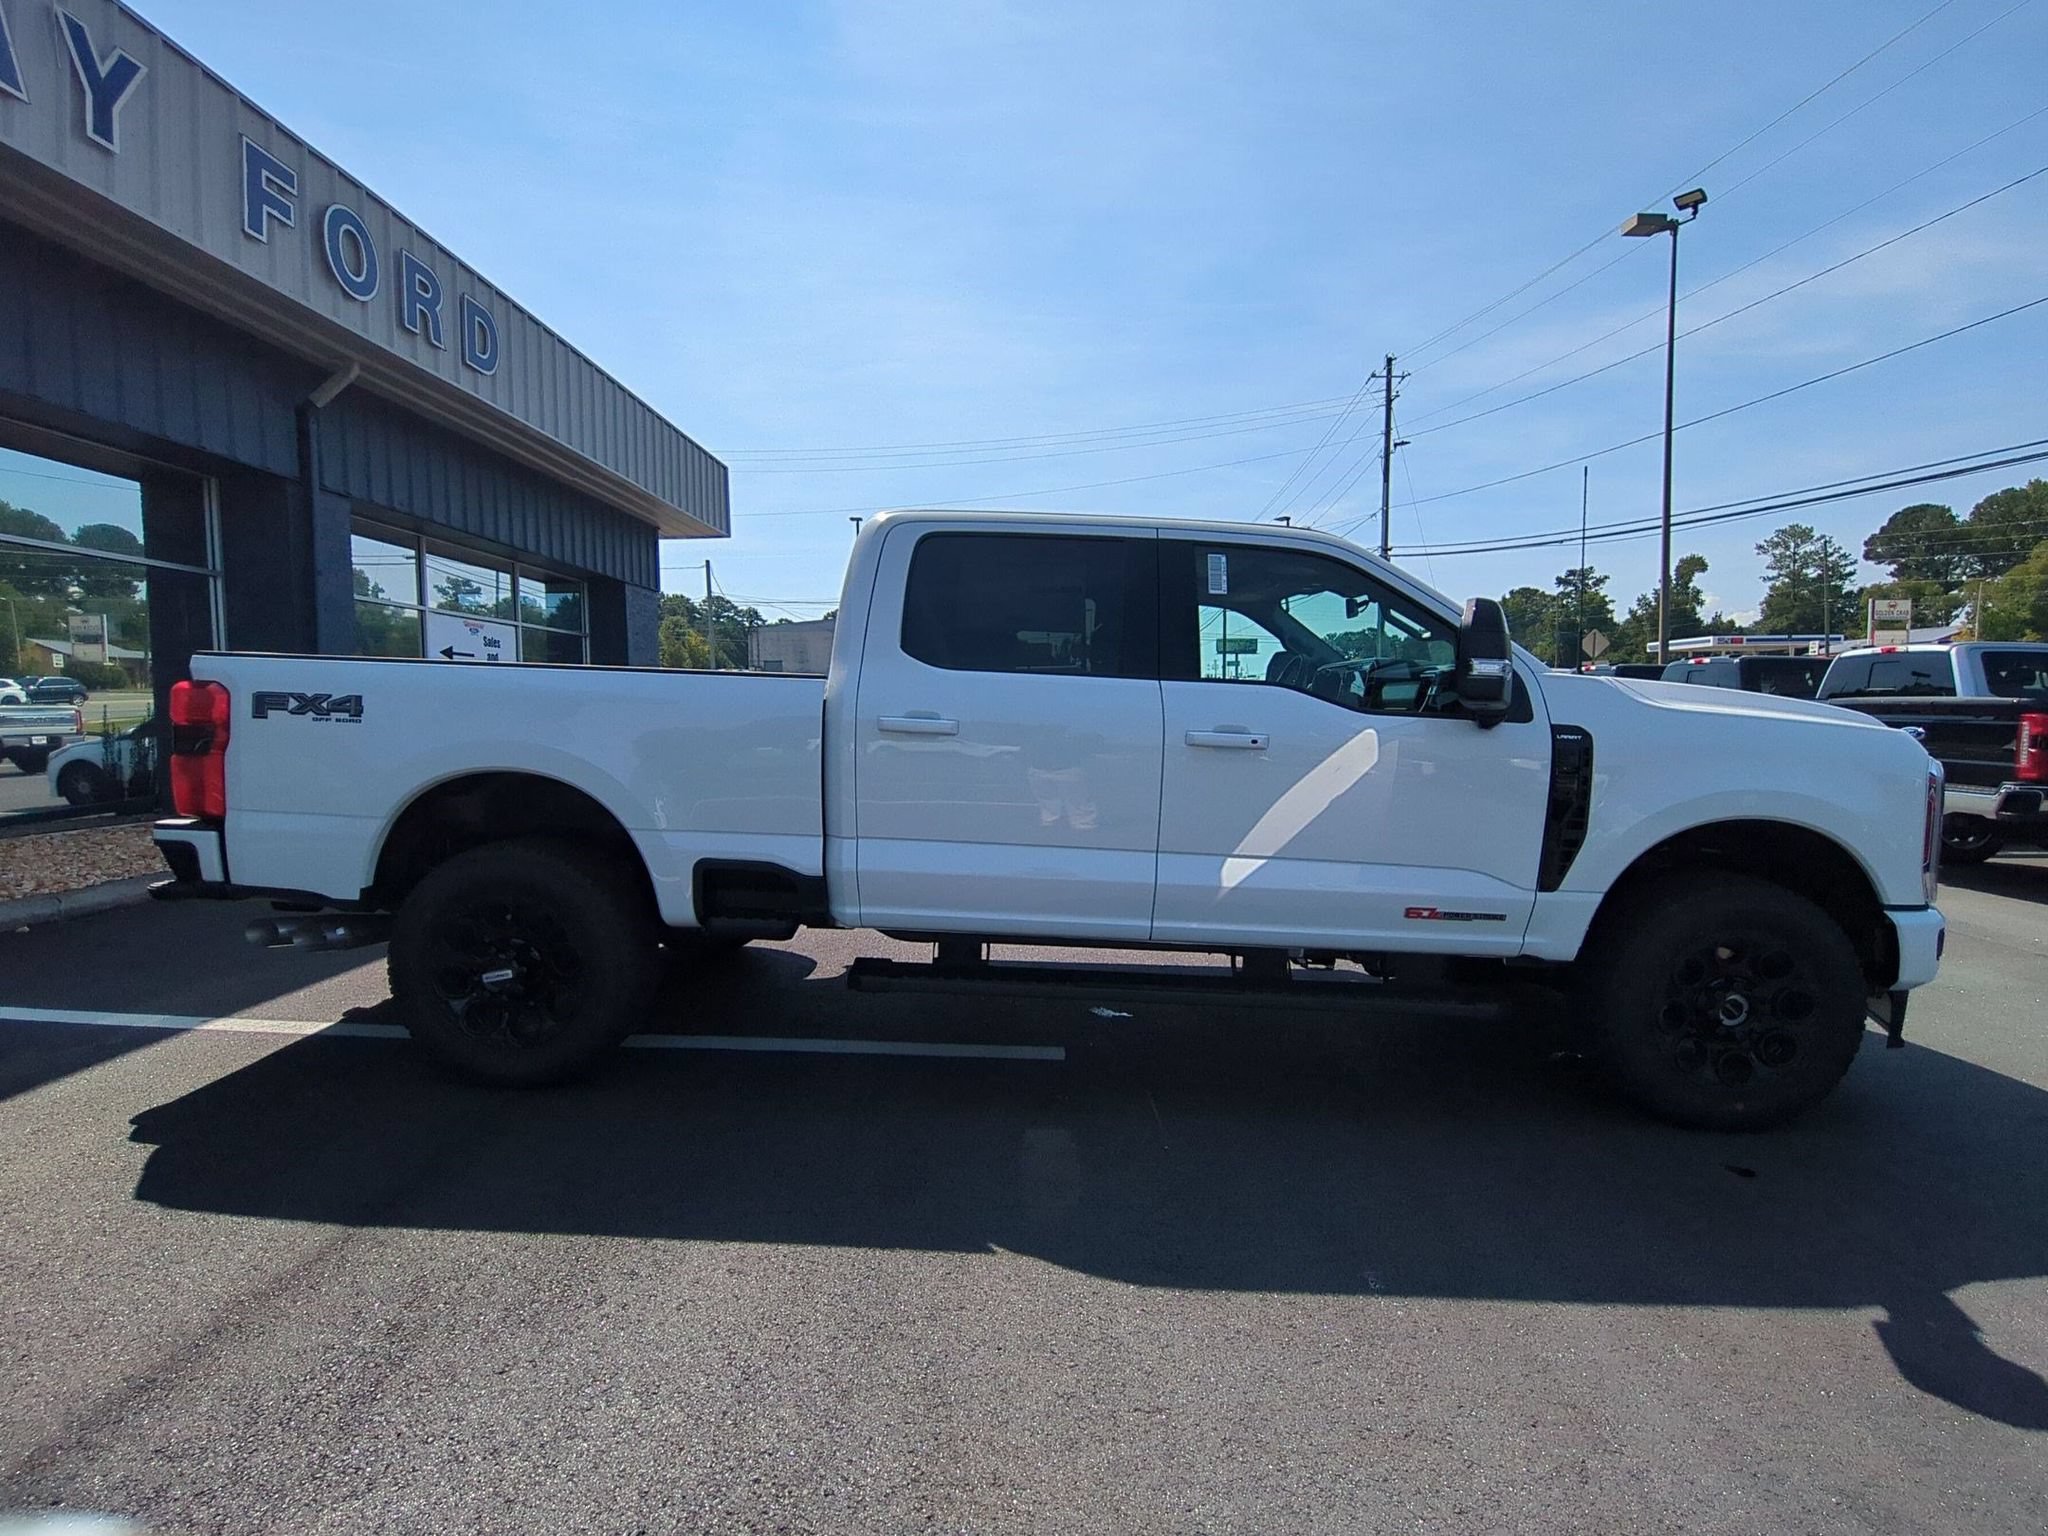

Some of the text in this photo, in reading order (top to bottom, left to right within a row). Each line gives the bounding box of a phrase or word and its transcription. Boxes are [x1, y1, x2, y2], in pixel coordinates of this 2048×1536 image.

[241, 133, 501, 377] FORD
[483, 635, 501, 649] Sales
[252, 691, 364, 719] FX4
